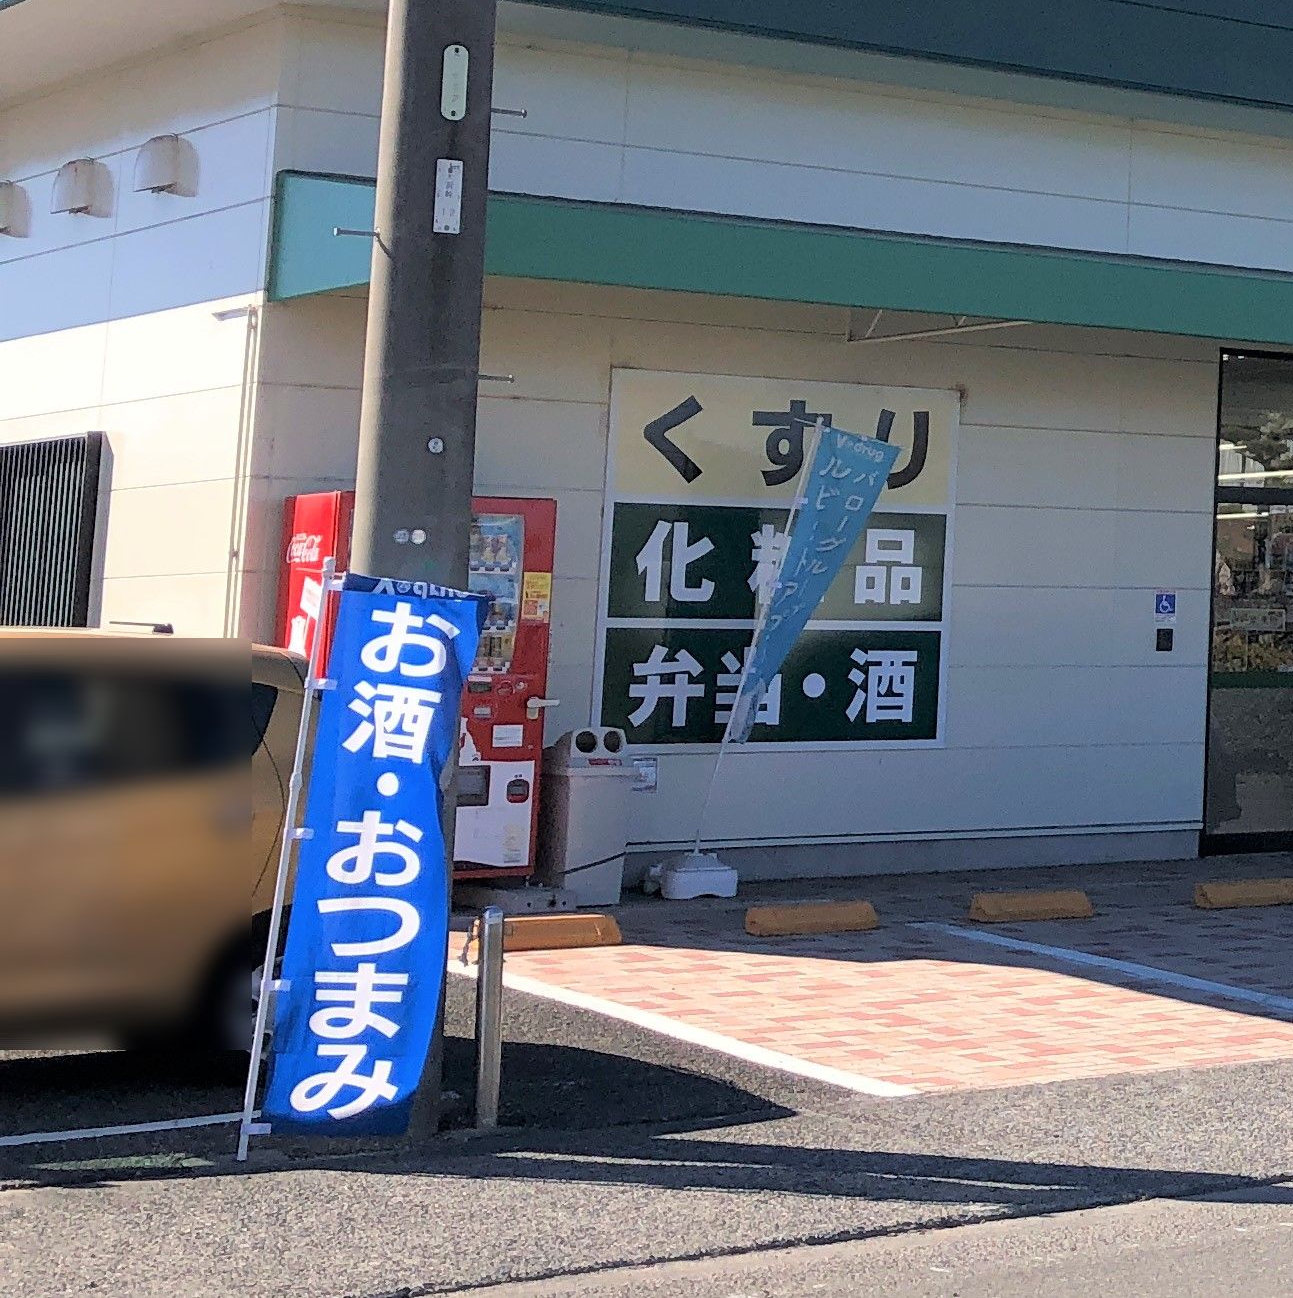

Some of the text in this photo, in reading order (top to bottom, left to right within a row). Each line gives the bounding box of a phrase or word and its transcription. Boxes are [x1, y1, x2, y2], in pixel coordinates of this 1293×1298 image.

[643, 395, 930, 489] くすり
[289, 601, 459, 1120] お酒・おつまみ
